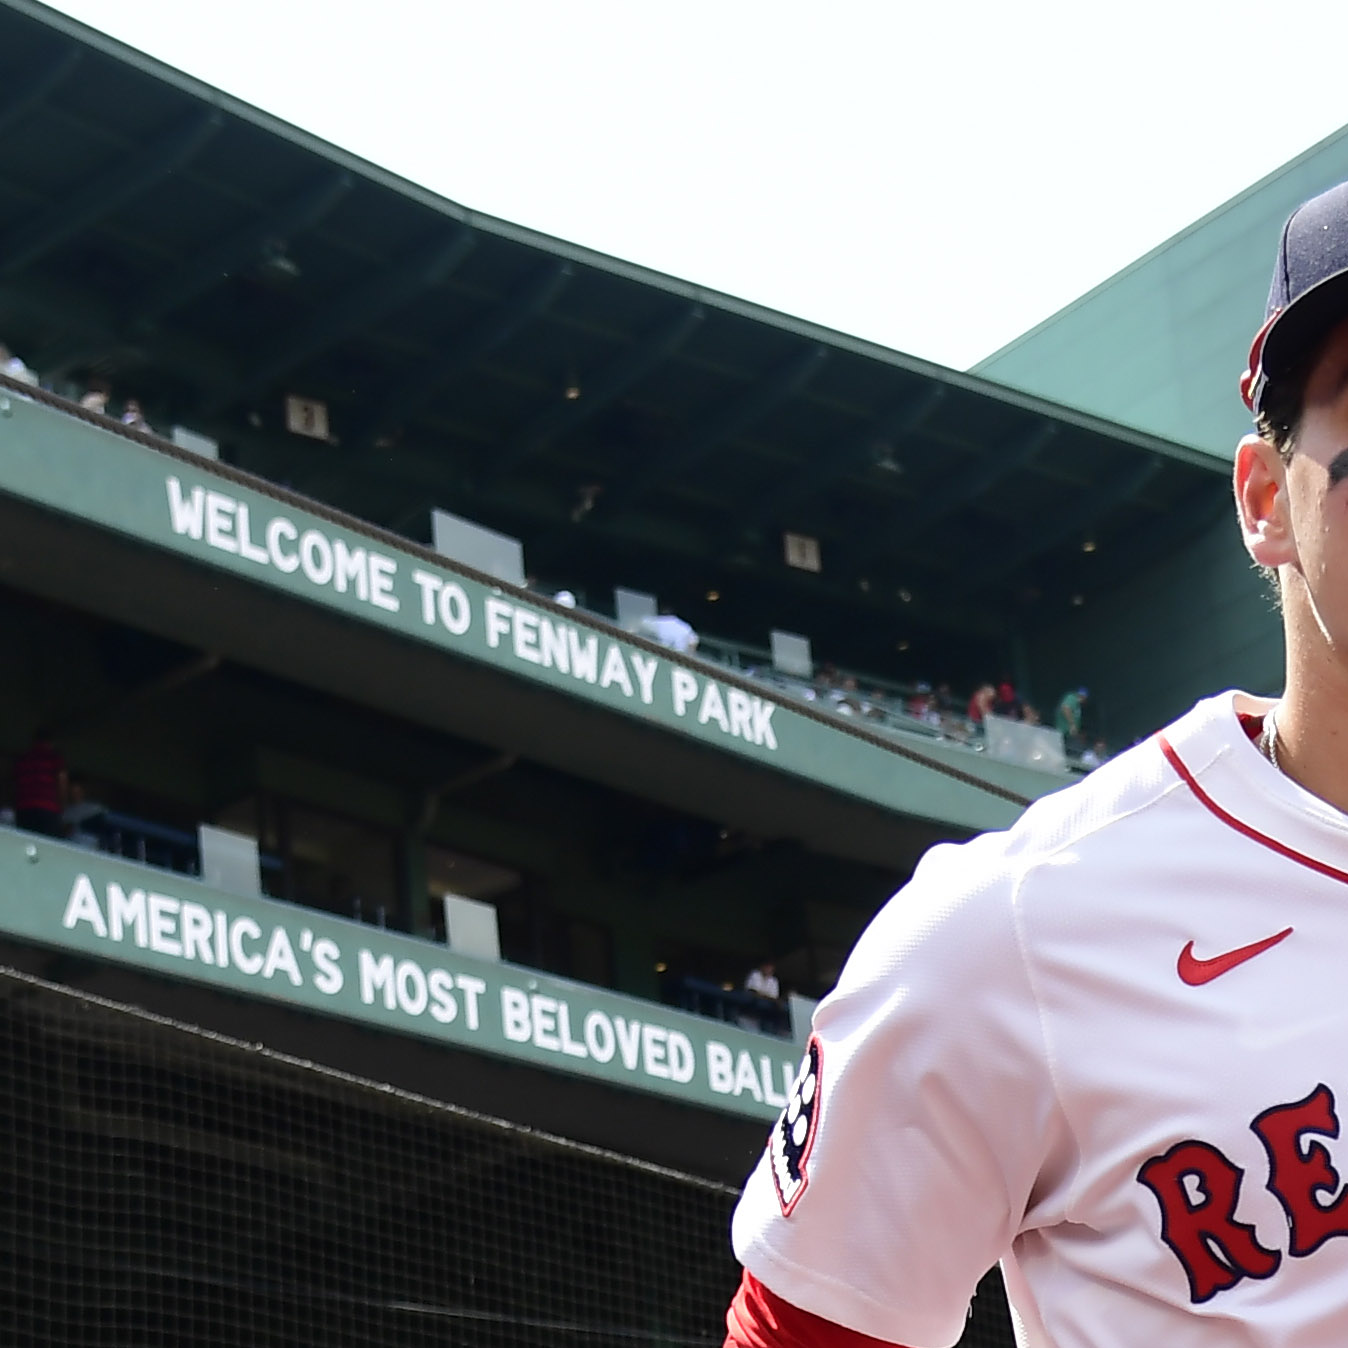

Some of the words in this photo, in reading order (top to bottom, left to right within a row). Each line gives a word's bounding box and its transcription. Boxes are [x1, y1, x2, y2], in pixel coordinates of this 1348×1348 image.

[165, 475, 400, 612] WELCOME
[412, 568, 472, 636] TO
[485, 600, 659, 704] FENWAY
[672, 669, 778, 750] PARK
[61, 873, 344, 996] AMERICA'S
[358, 952, 487, 1033] MOST
[502, 990, 696, 1086] BELOVED
